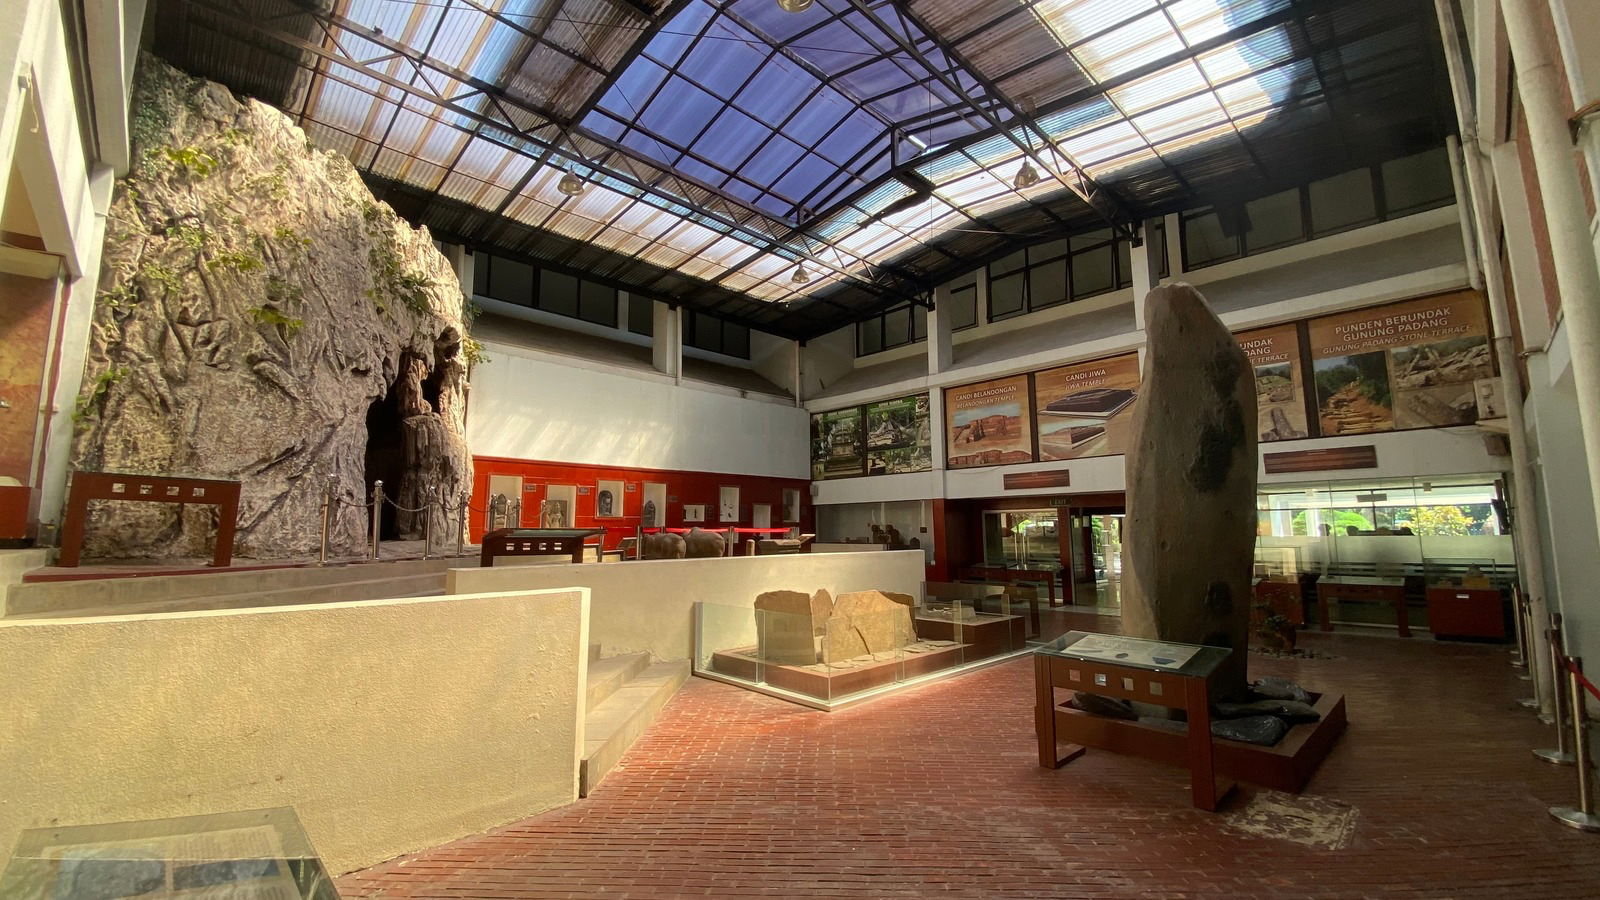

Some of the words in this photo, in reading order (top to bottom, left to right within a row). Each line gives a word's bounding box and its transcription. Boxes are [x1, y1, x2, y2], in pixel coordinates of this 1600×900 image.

[1335, 319, 1382, 335] PUNDEN
[1385, 307, 1451, 326] BERUNDAK
[1343, 326, 1394, 342] GUNUNG
[1398, 317, 1448, 333] PADANG
[1240, 337, 1274, 350] UNDAK
[1322, 342, 1360, 355] GUNUNG
[1362, 336, 1398, 348] PADANG
[1400, 332, 1429, 341] STONE
[1432, 324, 1472, 337] TERRACE
[1243, 346, 1271, 357] DANG
[1257, 352, 1289, 363] TERRACE
[1065, 372, 1088, 382] CANDI
[1088, 369, 1106, 378] JIWA
[1082, 378, 1105, 387] TEMPLE
[955, 393, 973, 402] CANDI
[973, 385, 1017, 399] BELANDONGAN
[994, 394, 1014, 403] TEMPLE
